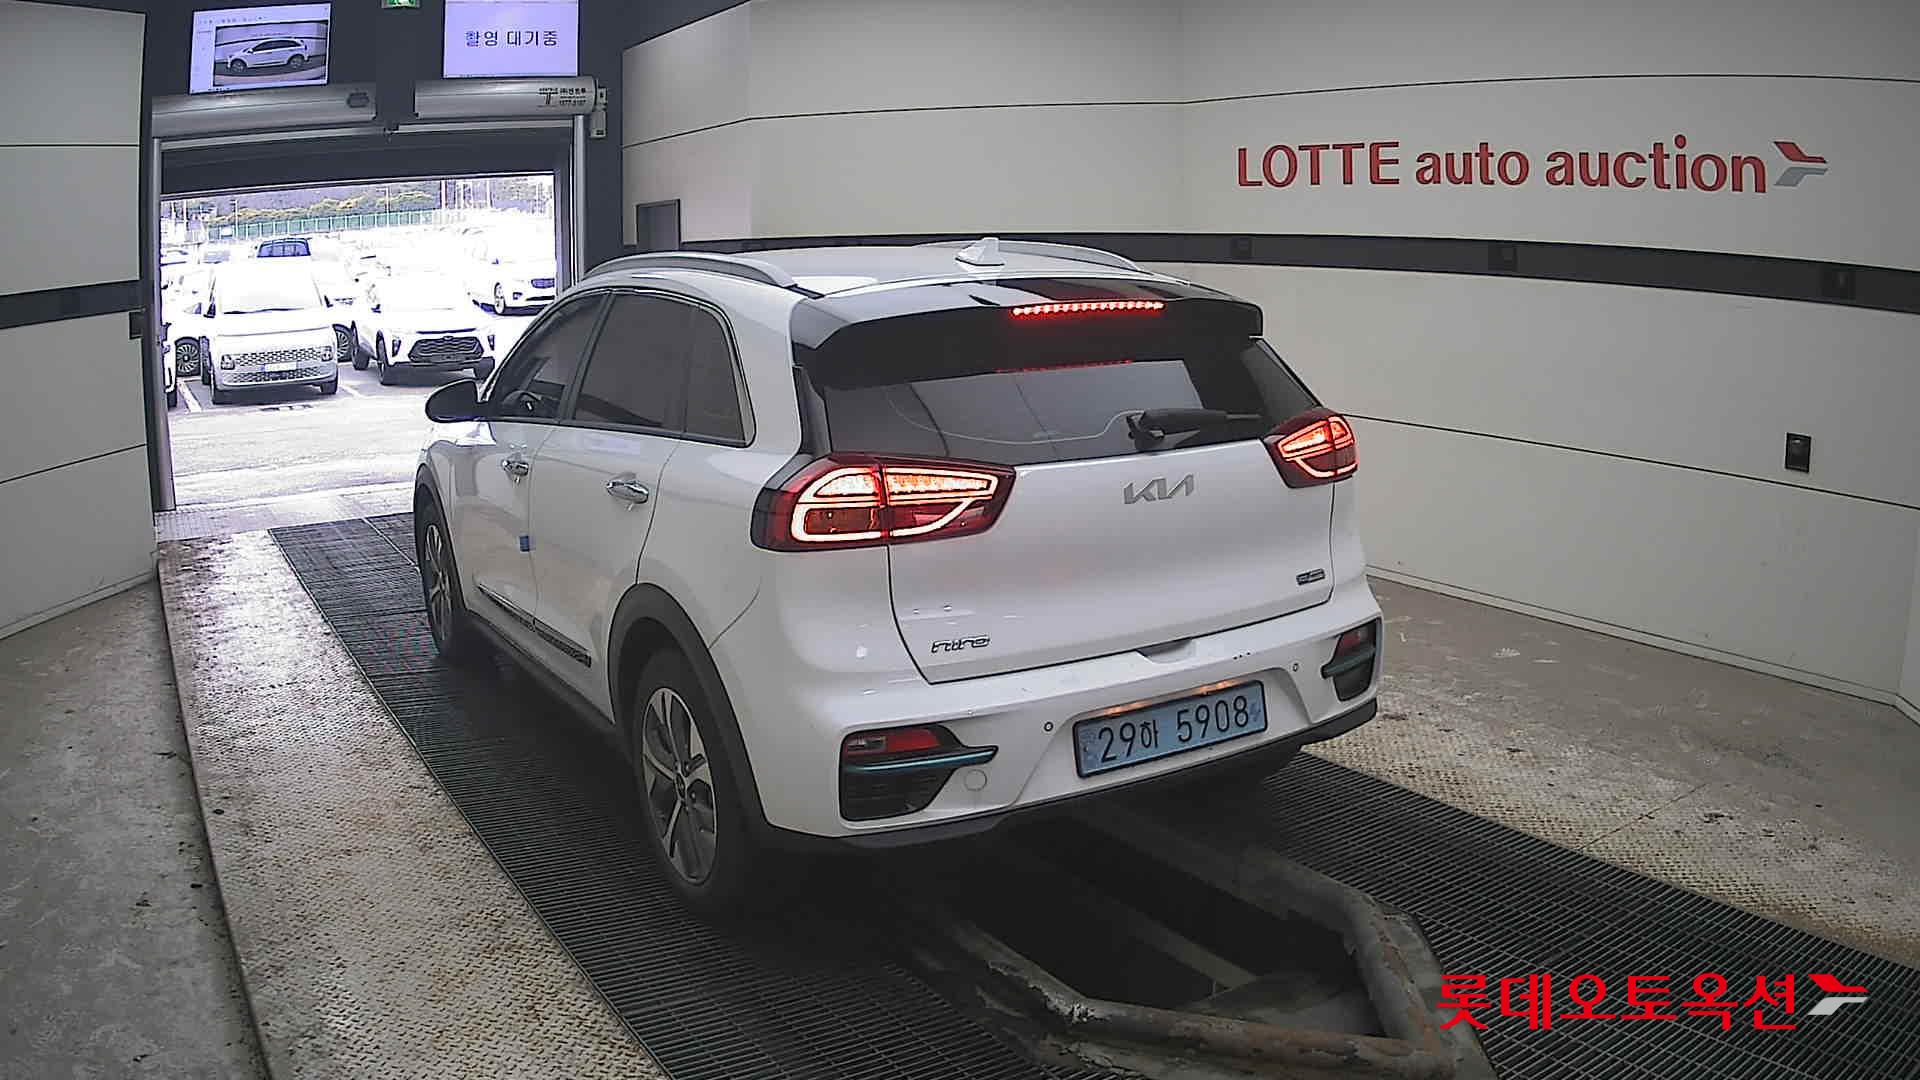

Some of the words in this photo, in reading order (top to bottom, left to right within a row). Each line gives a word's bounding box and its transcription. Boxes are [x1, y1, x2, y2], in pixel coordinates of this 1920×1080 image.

[506, 30, 558, 46] 대기중
[1237, 142, 1400, 187] LOTTE
[1415, 142, 1530, 186] auto
[1545, 135, 1767, 194] auction
[1123, 473, 1195, 505] KIA
[1098, 719, 1159, 763] 29하
[1176, 695, 1249, 742] 5908
